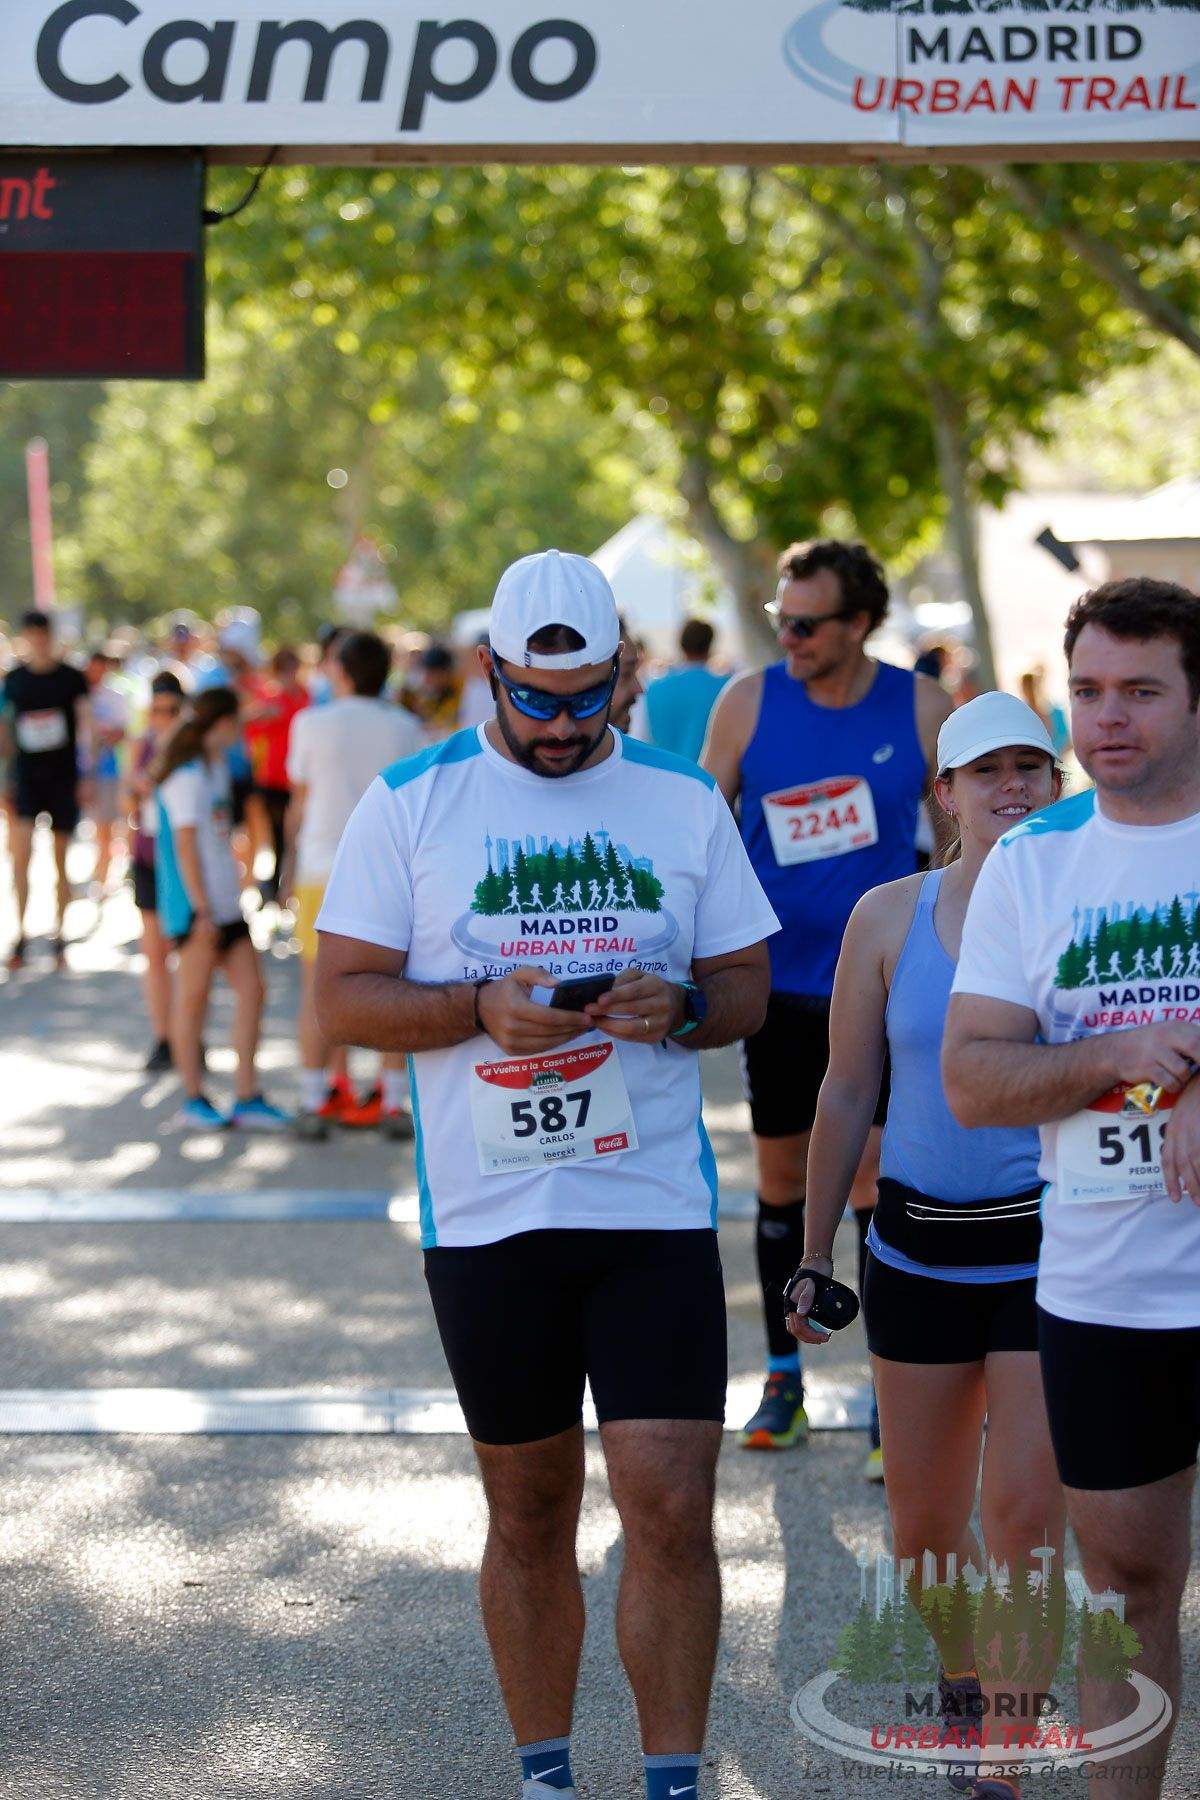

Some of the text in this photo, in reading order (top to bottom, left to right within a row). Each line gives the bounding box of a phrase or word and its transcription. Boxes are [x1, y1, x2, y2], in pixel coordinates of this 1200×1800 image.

[908, 25, 1142, 64] MADRID
[36, 0, 597, 131] Campo
[852, 76, 1197, 113] URBAN TRAIL
[788, 802, 858, 840] 2244
[520, 917, 618, 935] MADRID
[500, 938, 637, 957] URBAN TRAIL
[464, 966, 478, 979] La
[550, 962, 562, 974] la
[567, 961, 603, 973] Casa
[606, 959, 623, 971] de
[1099, 985, 1200, 1007] MADRID
[1083, 1010, 1154, 1027] URBAN
[493, 1065, 520, 1074] Vuelta
[530, 1062, 539, 1070] la
[542, 1059, 565, 1068] Casa
[567, 1055, 577, 1063] de
[578, 1049, 607, 1060] Campo
[511, 1089, 592, 1138] 587
[539, 1132, 575, 1145] CARLOS
[501, 1155, 530, 1165] MADRID
[1128, 1166, 1160, 1175] PEDRO
